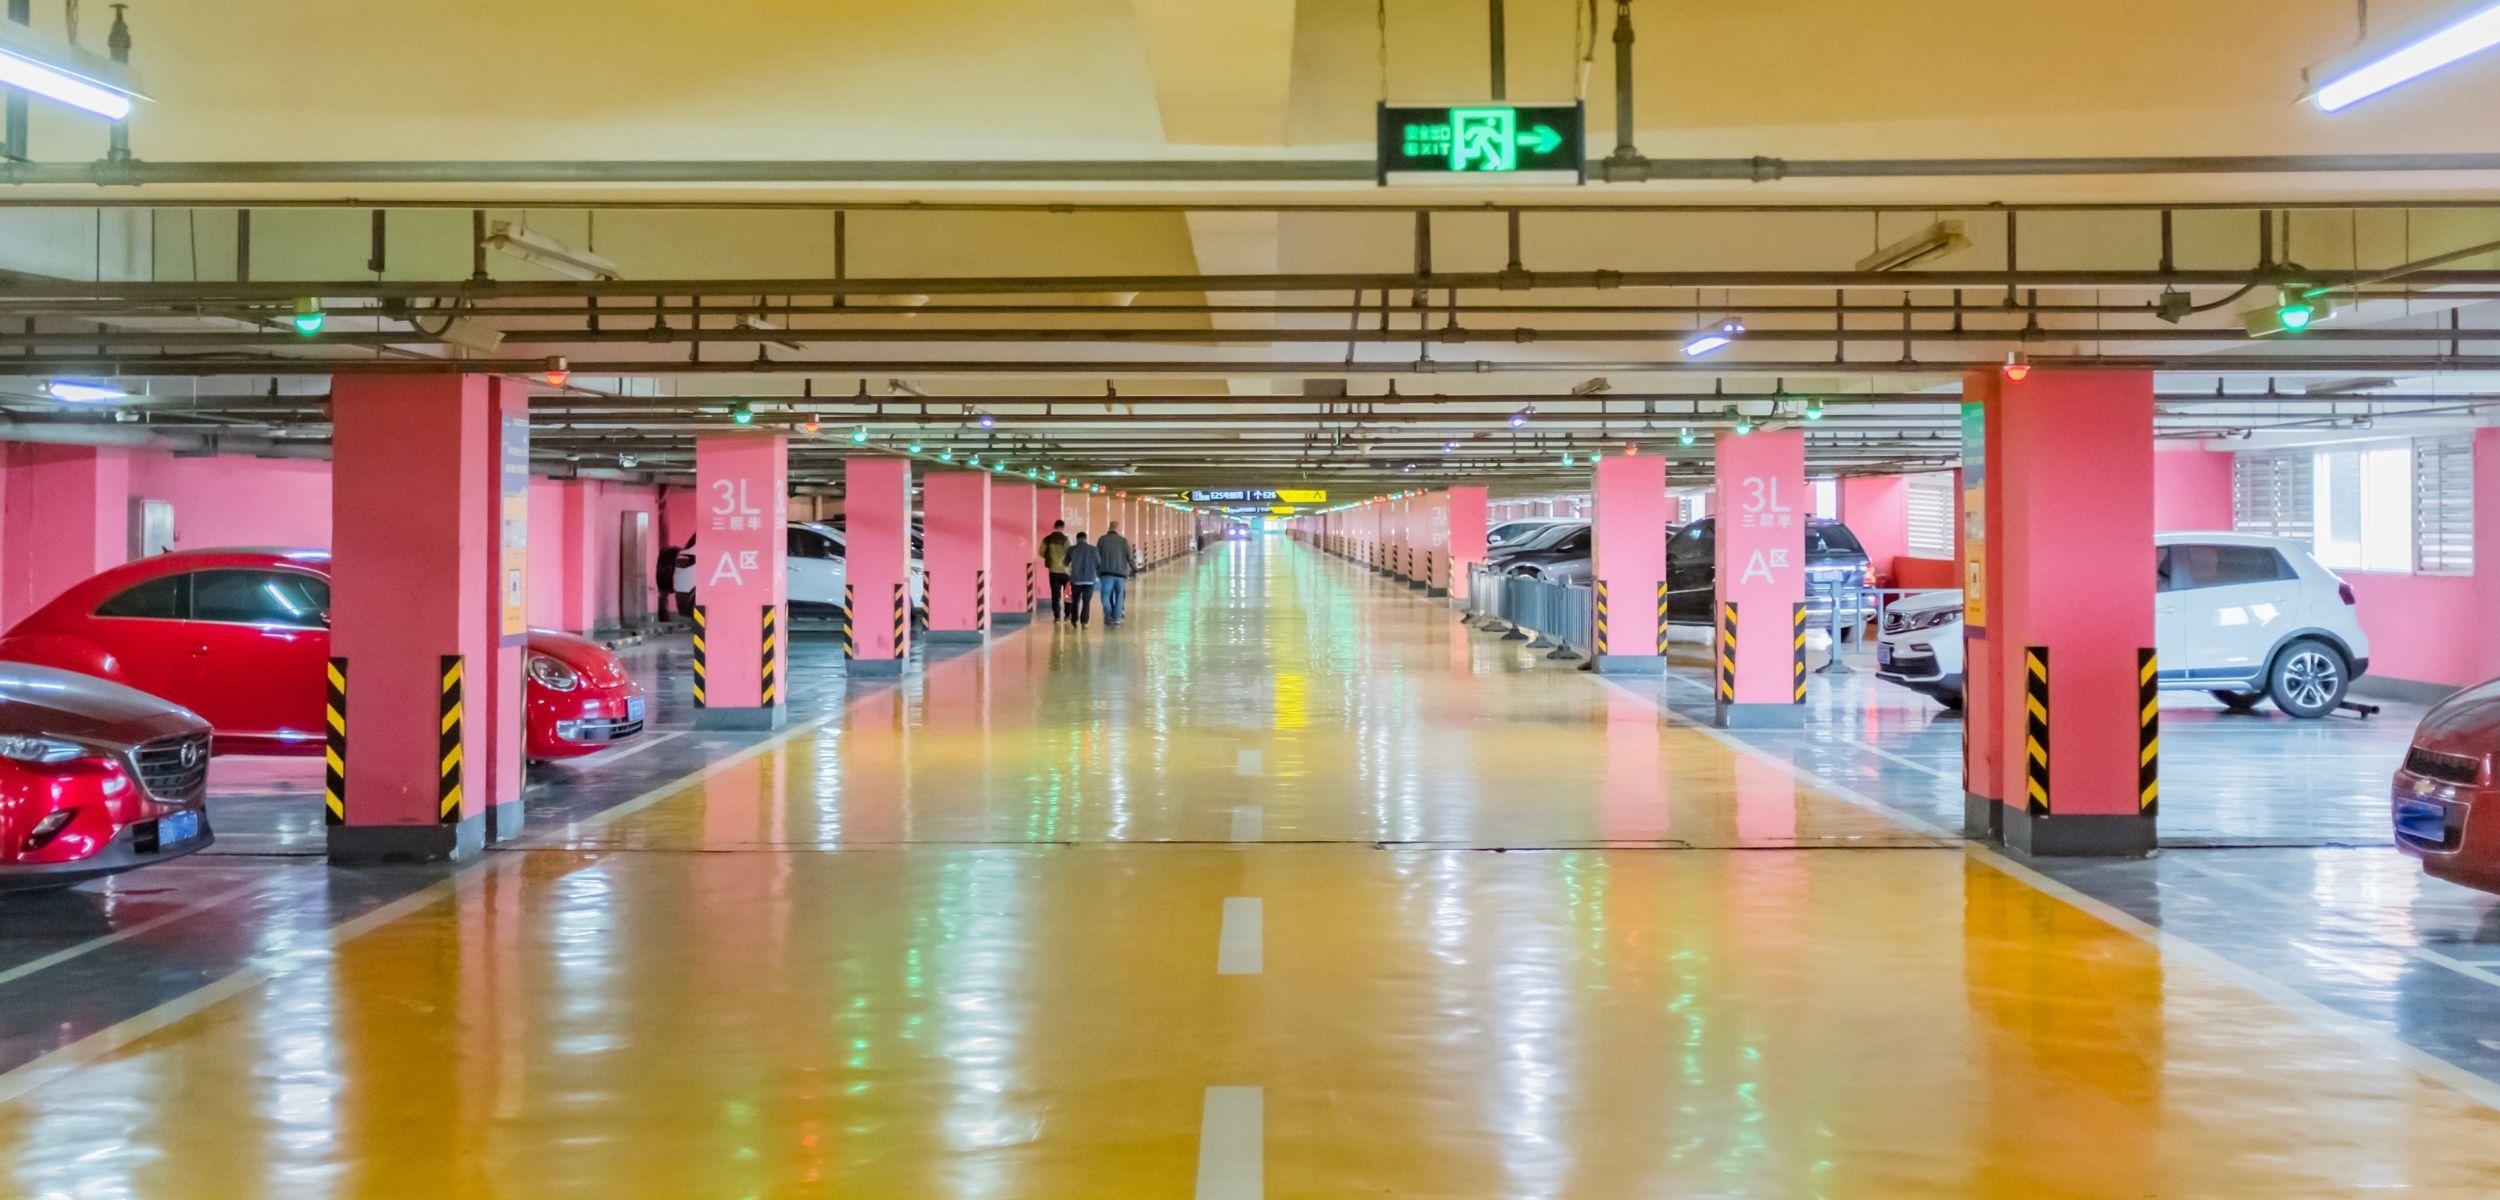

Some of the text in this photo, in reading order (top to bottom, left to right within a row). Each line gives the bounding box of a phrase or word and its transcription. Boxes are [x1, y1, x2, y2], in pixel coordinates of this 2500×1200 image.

[1404, 142, 1450, 157] EXIT
[711, 479, 761, 515] 3L
[1742, 476, 1792, 513] 3L
